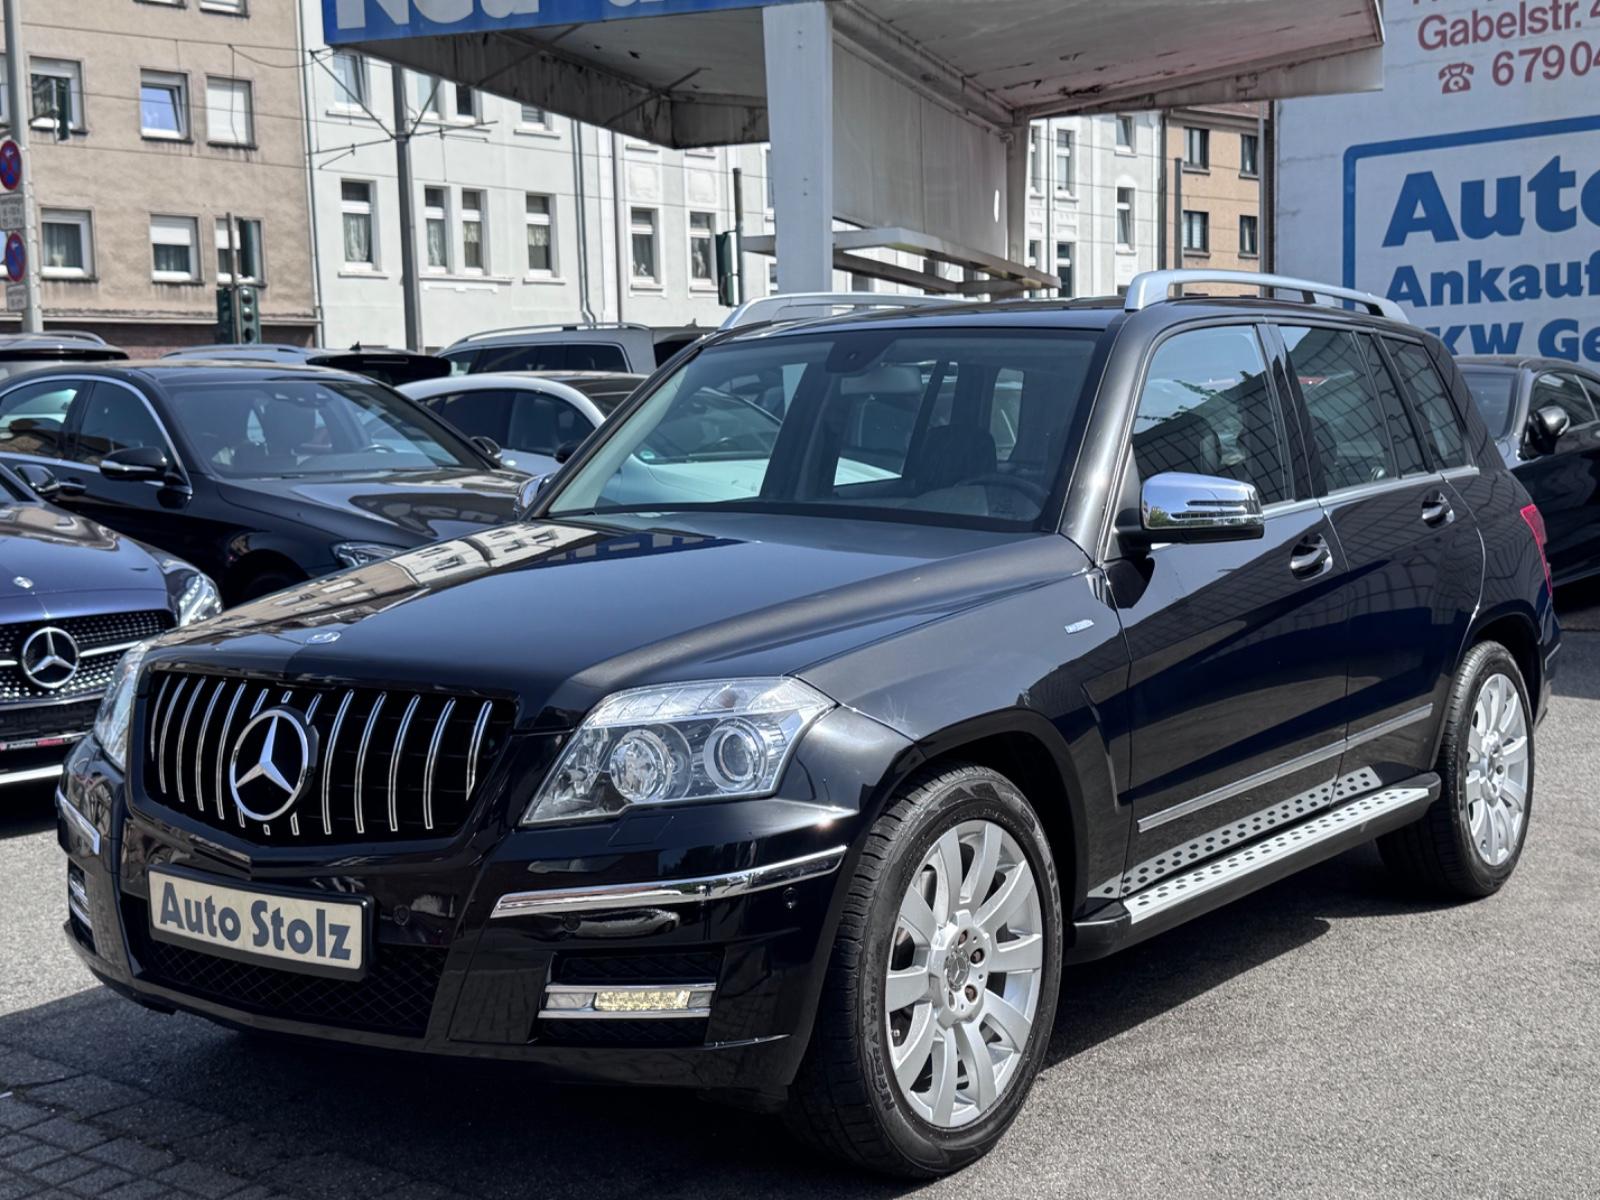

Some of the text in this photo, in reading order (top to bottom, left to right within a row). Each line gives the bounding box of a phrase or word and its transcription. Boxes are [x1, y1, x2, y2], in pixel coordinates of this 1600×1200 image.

[1418, 1, 1581, 50] Gabelstr.
[160, 881, 352, 961] Auto Stolz
